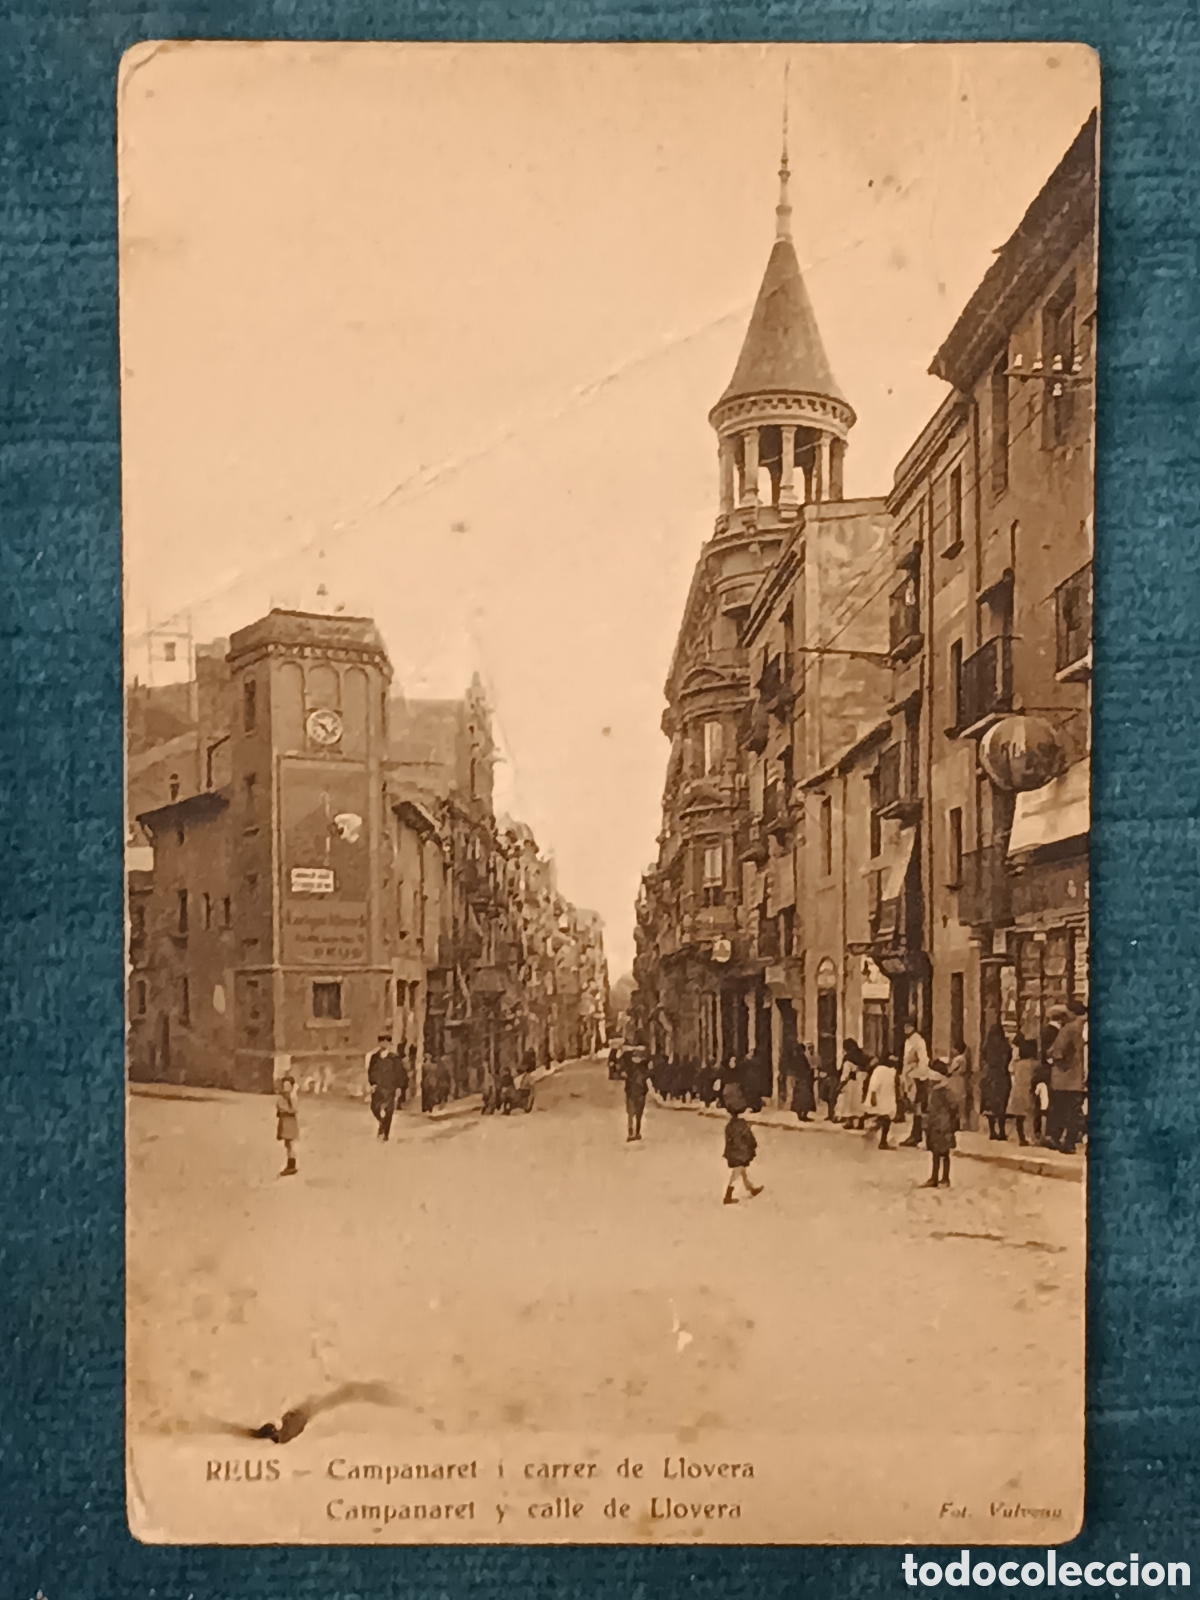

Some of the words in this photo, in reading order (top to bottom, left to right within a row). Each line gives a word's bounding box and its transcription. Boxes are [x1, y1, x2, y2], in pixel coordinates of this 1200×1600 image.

[206, 1459, 281, 1482] REUS
[327, 1458, 477, 1485] Campanaret
[524, 1463, 598, 1479] carrer
[616, 1457, 643, 1479] de
[663, 1457, 755, 1480] Llovera
[326, 1498, 475, 1524] Campanaret
[496, 1503, 510, 1524] y
[527, 1497, 584, 1519] calle
[603, 1497, 631, 1519] de
[650, 1497, 741, 1519] Llovera
